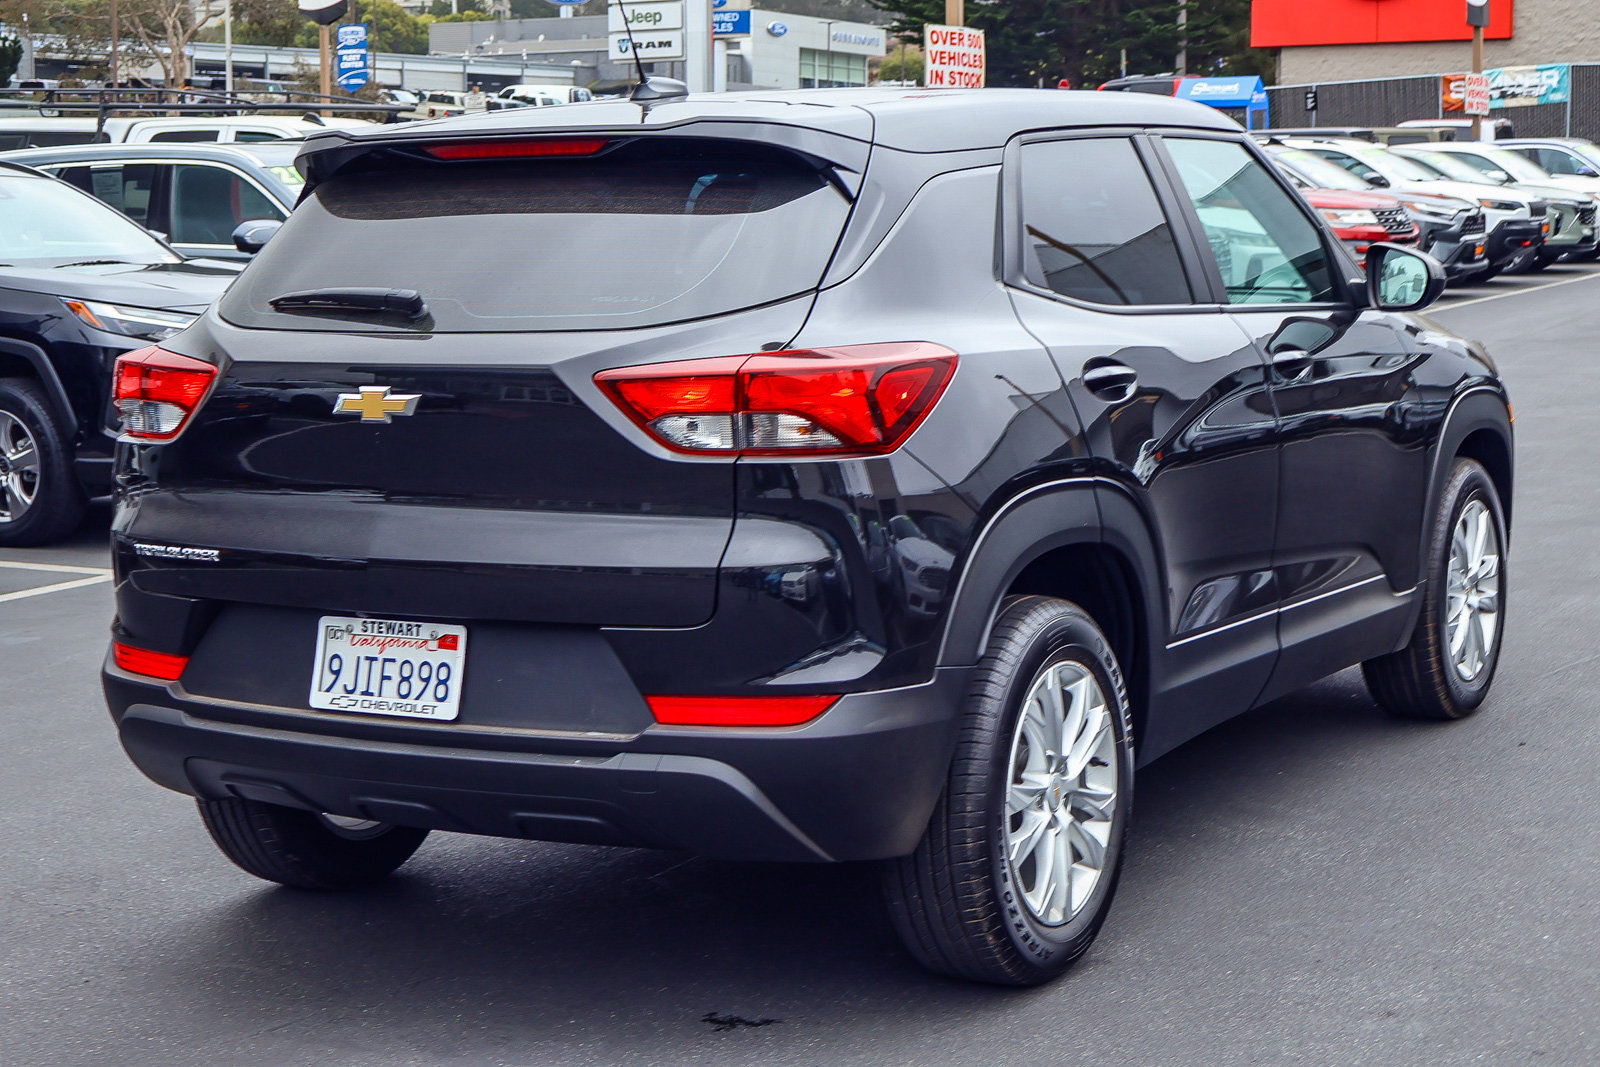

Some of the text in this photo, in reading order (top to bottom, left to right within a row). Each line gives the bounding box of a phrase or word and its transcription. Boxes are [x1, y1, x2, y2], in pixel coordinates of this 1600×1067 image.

[626, 9, 662, 25] Jeep
[634, 40, 673, 49] RAM
[930, 29, 965, 46] OVER
[929, 50, 983, 69] VEHICLES
[930, 70, 982, 88] IN STOCK
[361, 620, 422, 637] STEWART
[349, 633, 438, 655] California
[324, 652, 451, 703] 9JIF898
[360, 699, 438, 715] CHEVROLET
